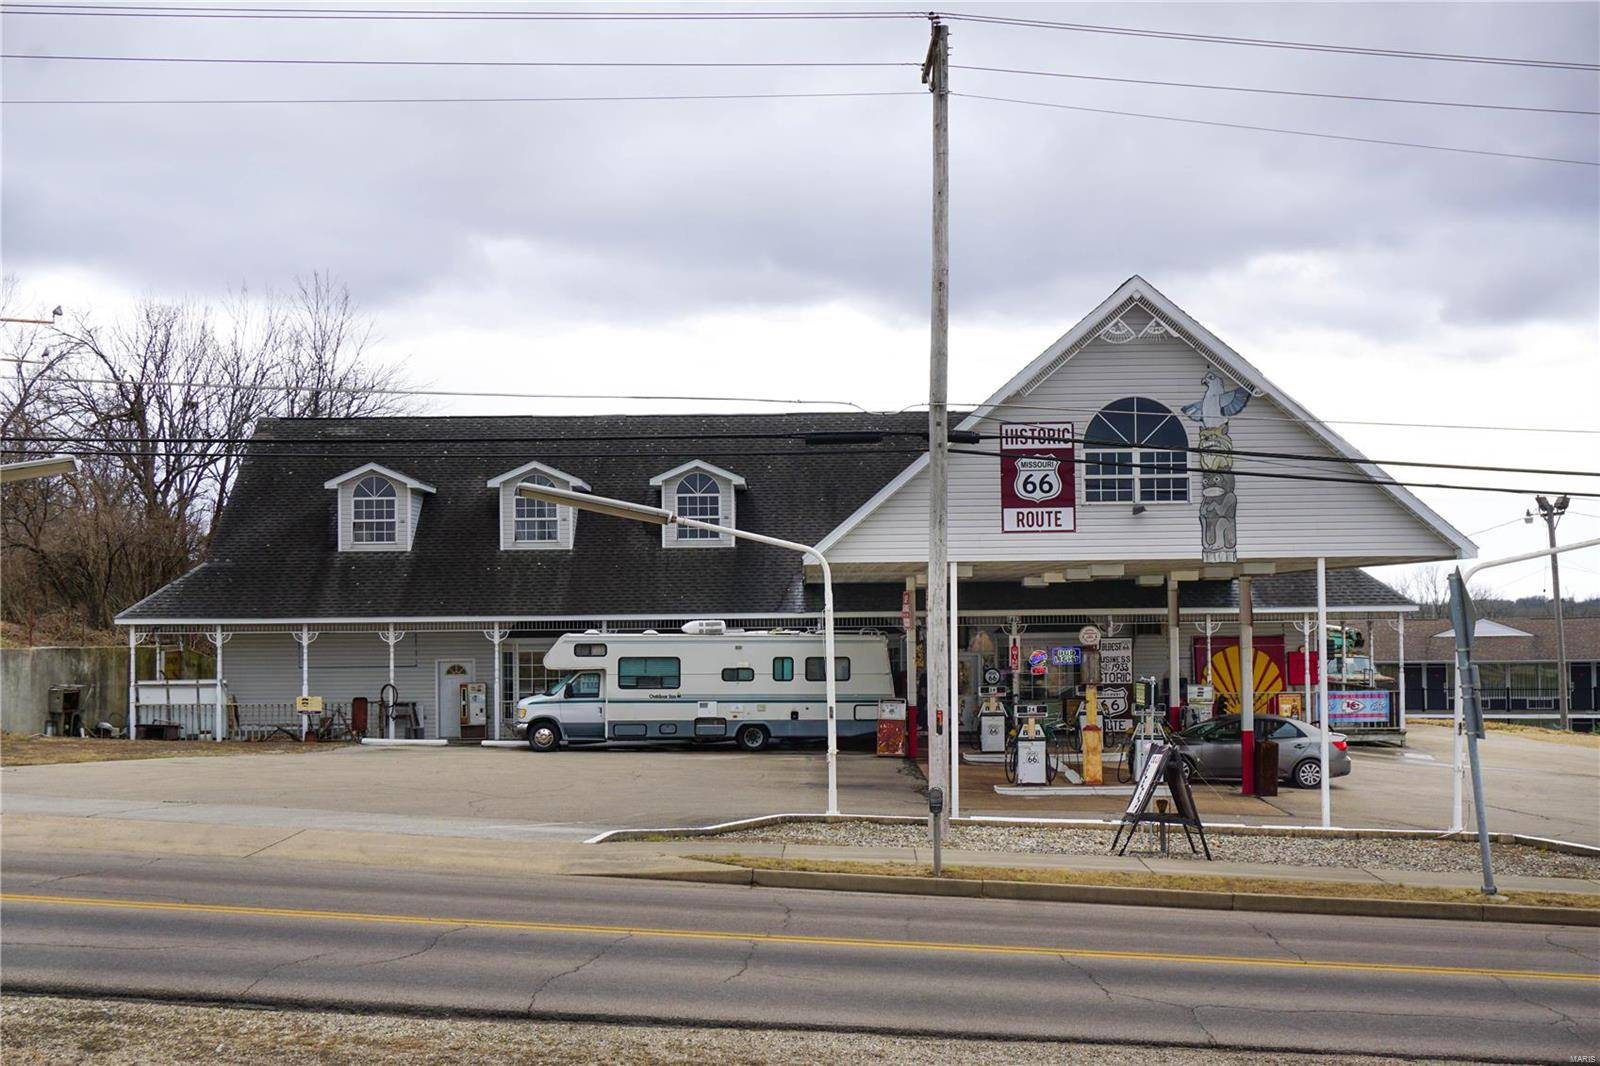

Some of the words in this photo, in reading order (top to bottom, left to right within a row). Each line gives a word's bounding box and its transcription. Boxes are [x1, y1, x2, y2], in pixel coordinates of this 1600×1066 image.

[1005, 428, 1070, 445] HISTORIC
[1021, 461, 1054, 469] MISSOURI
[1023, 474, 1053, 494] 66
[1017, 511, 1062, 528] ROUTE
[1105, 720, 1126, 731] UTE
[1027, 755, 1038, 763] 66
